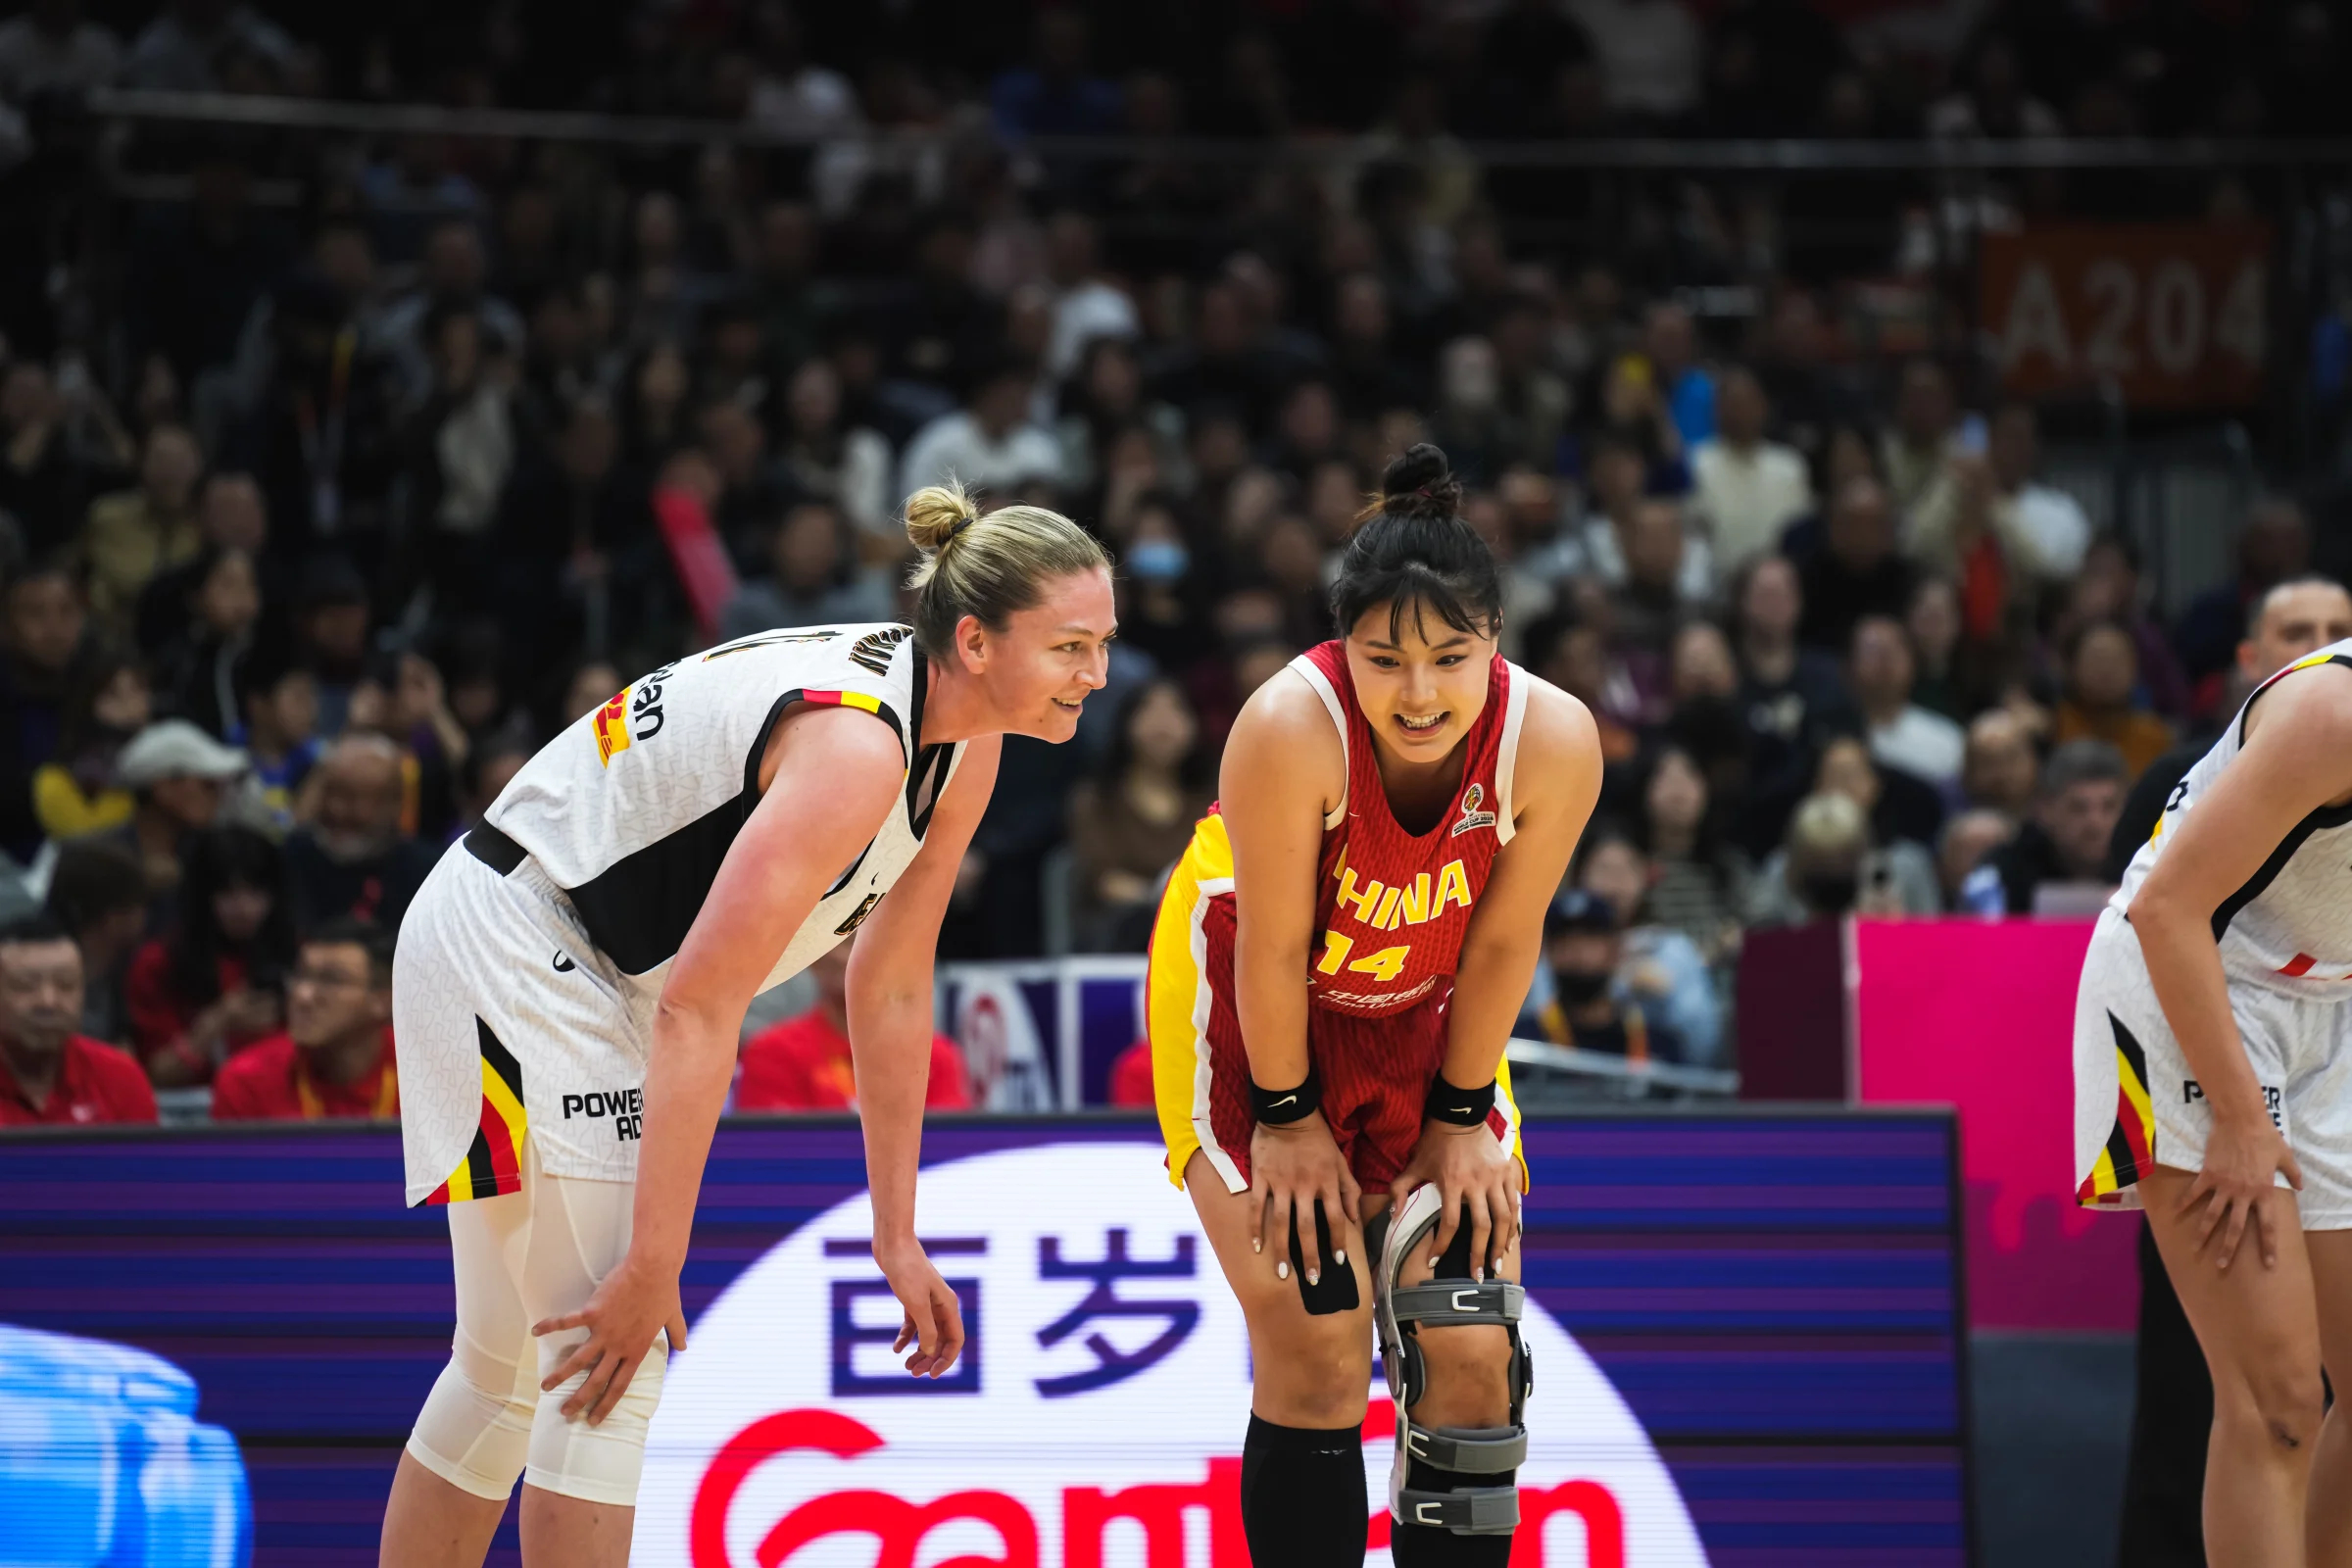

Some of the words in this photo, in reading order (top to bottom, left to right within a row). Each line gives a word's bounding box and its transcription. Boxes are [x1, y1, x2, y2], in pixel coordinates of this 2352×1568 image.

[2004, 258, 2267, 377] A204
[1333, 843, 1473, 932] HINA
[1316, 929, 1411, 982] 14
[823, 1228, 1254, 1399] 百岁
